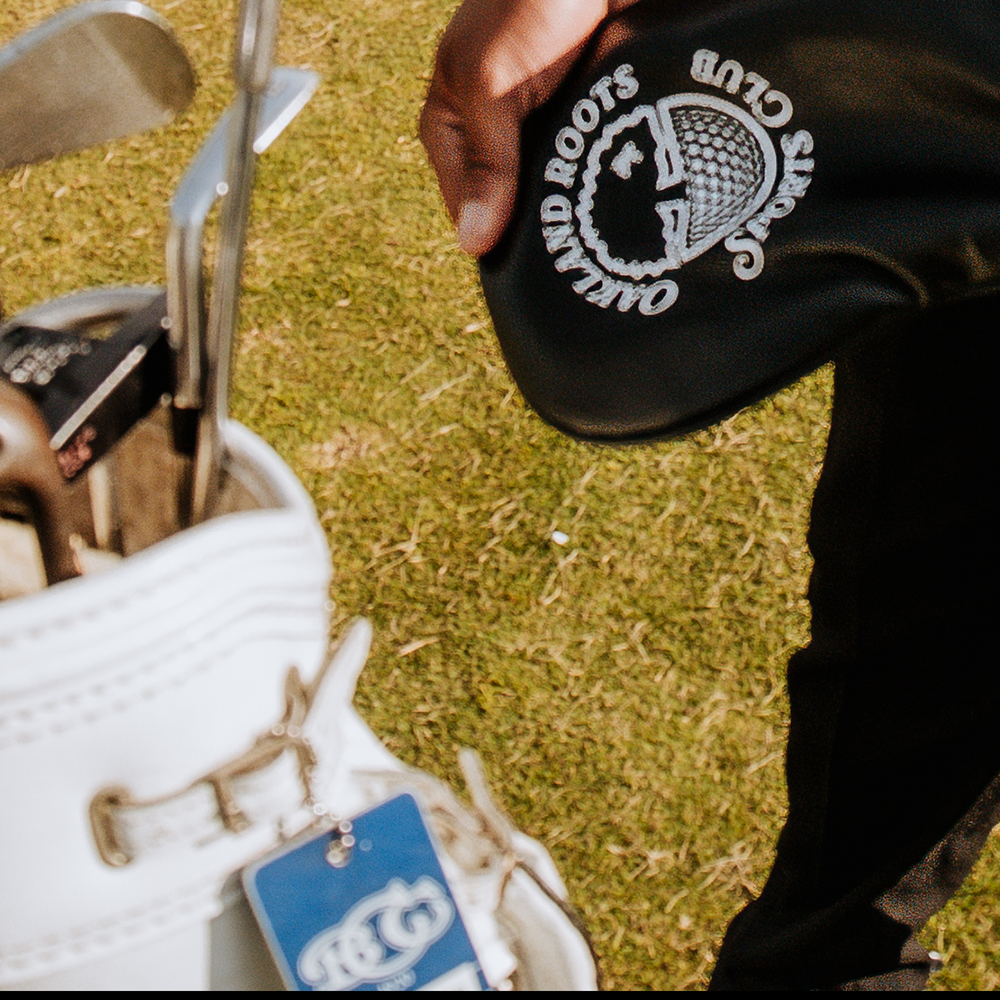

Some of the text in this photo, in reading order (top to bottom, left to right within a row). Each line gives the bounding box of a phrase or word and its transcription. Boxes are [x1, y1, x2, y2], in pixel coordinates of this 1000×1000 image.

[540, 63, 679, 316] OAKLAND ROOTS
[690, 48, 815, 281] SPORTS CLUB
